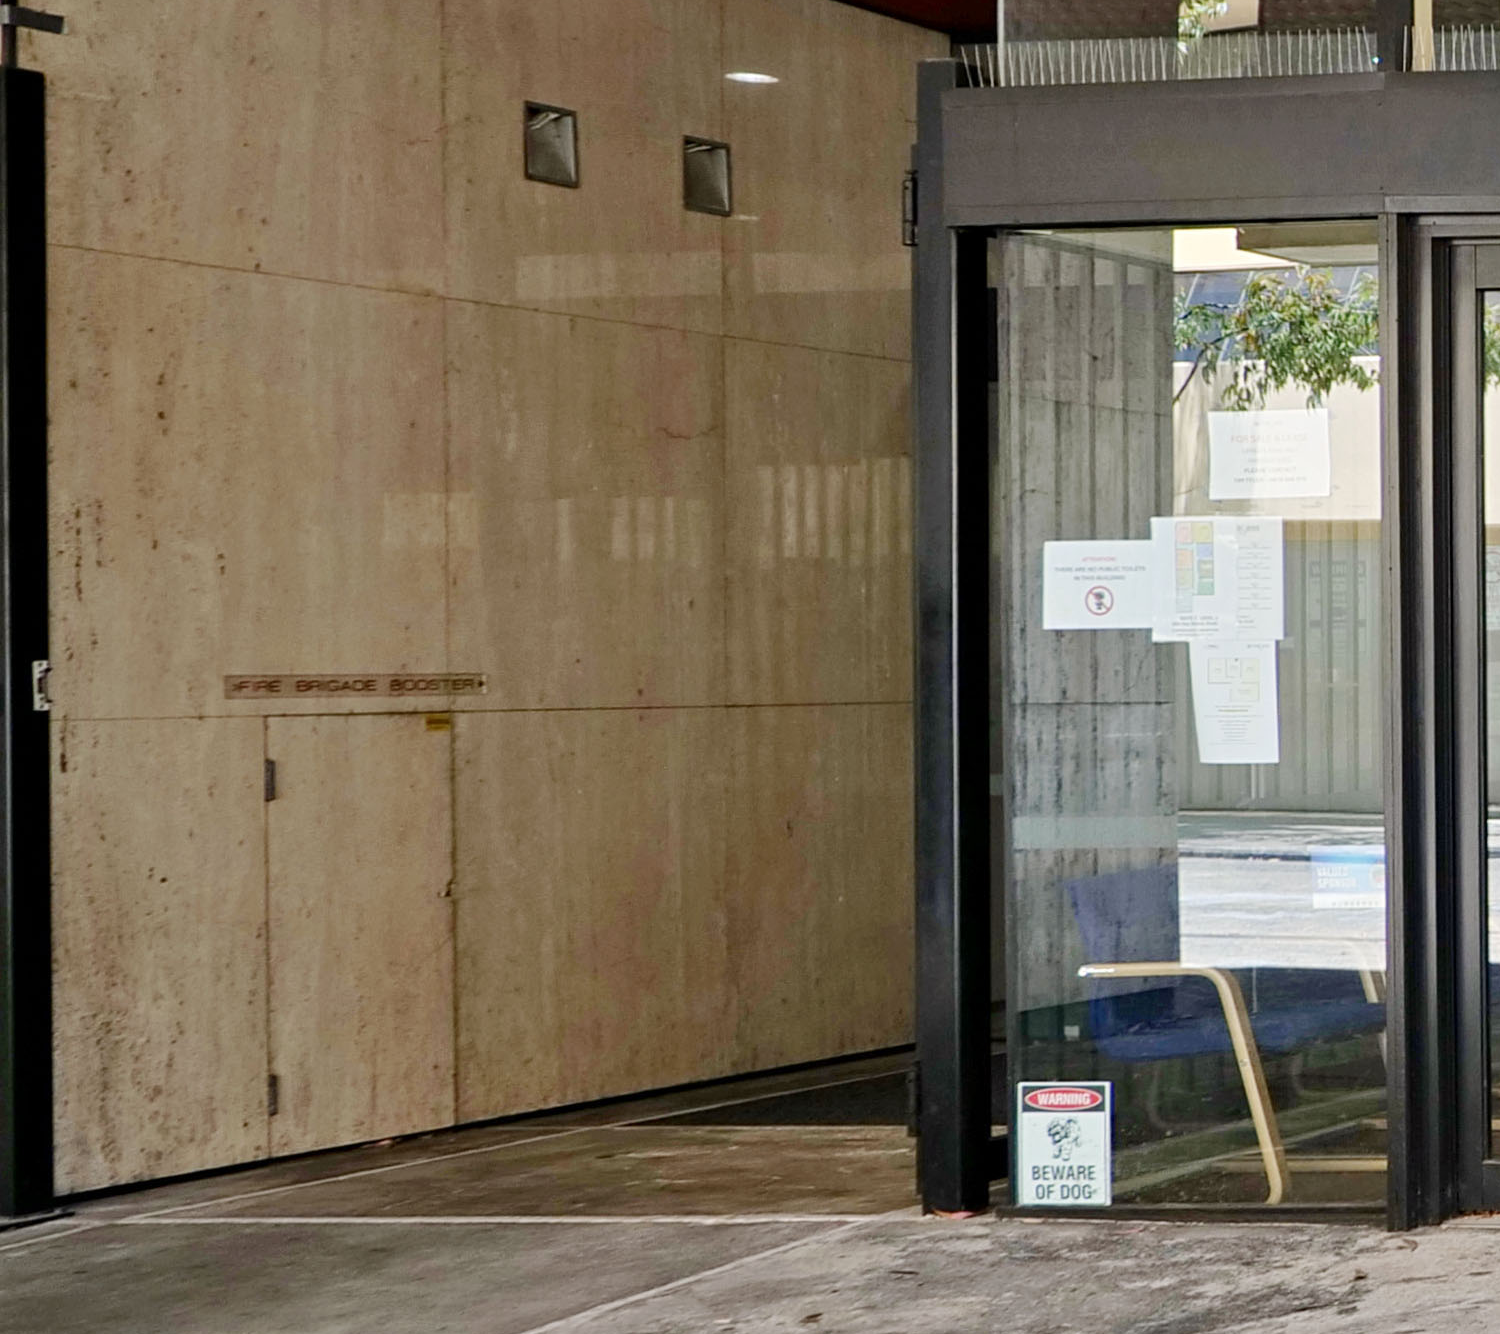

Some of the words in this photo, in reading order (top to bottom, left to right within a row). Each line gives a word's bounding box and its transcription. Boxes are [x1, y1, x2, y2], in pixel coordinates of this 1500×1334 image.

[239, 680, 281, 693] FIRE
[295, 679, 377, 693] BRIGADE
[389, 678, 475, 692] BOOSTER
[1037, 1093, 1091, 1105] WARNING
[1031, 1166, 1097, 1181] BEWARE
[1035, 1184, 1056, 1200] OF
[1060, 1184, 1093, 1200] DOG
